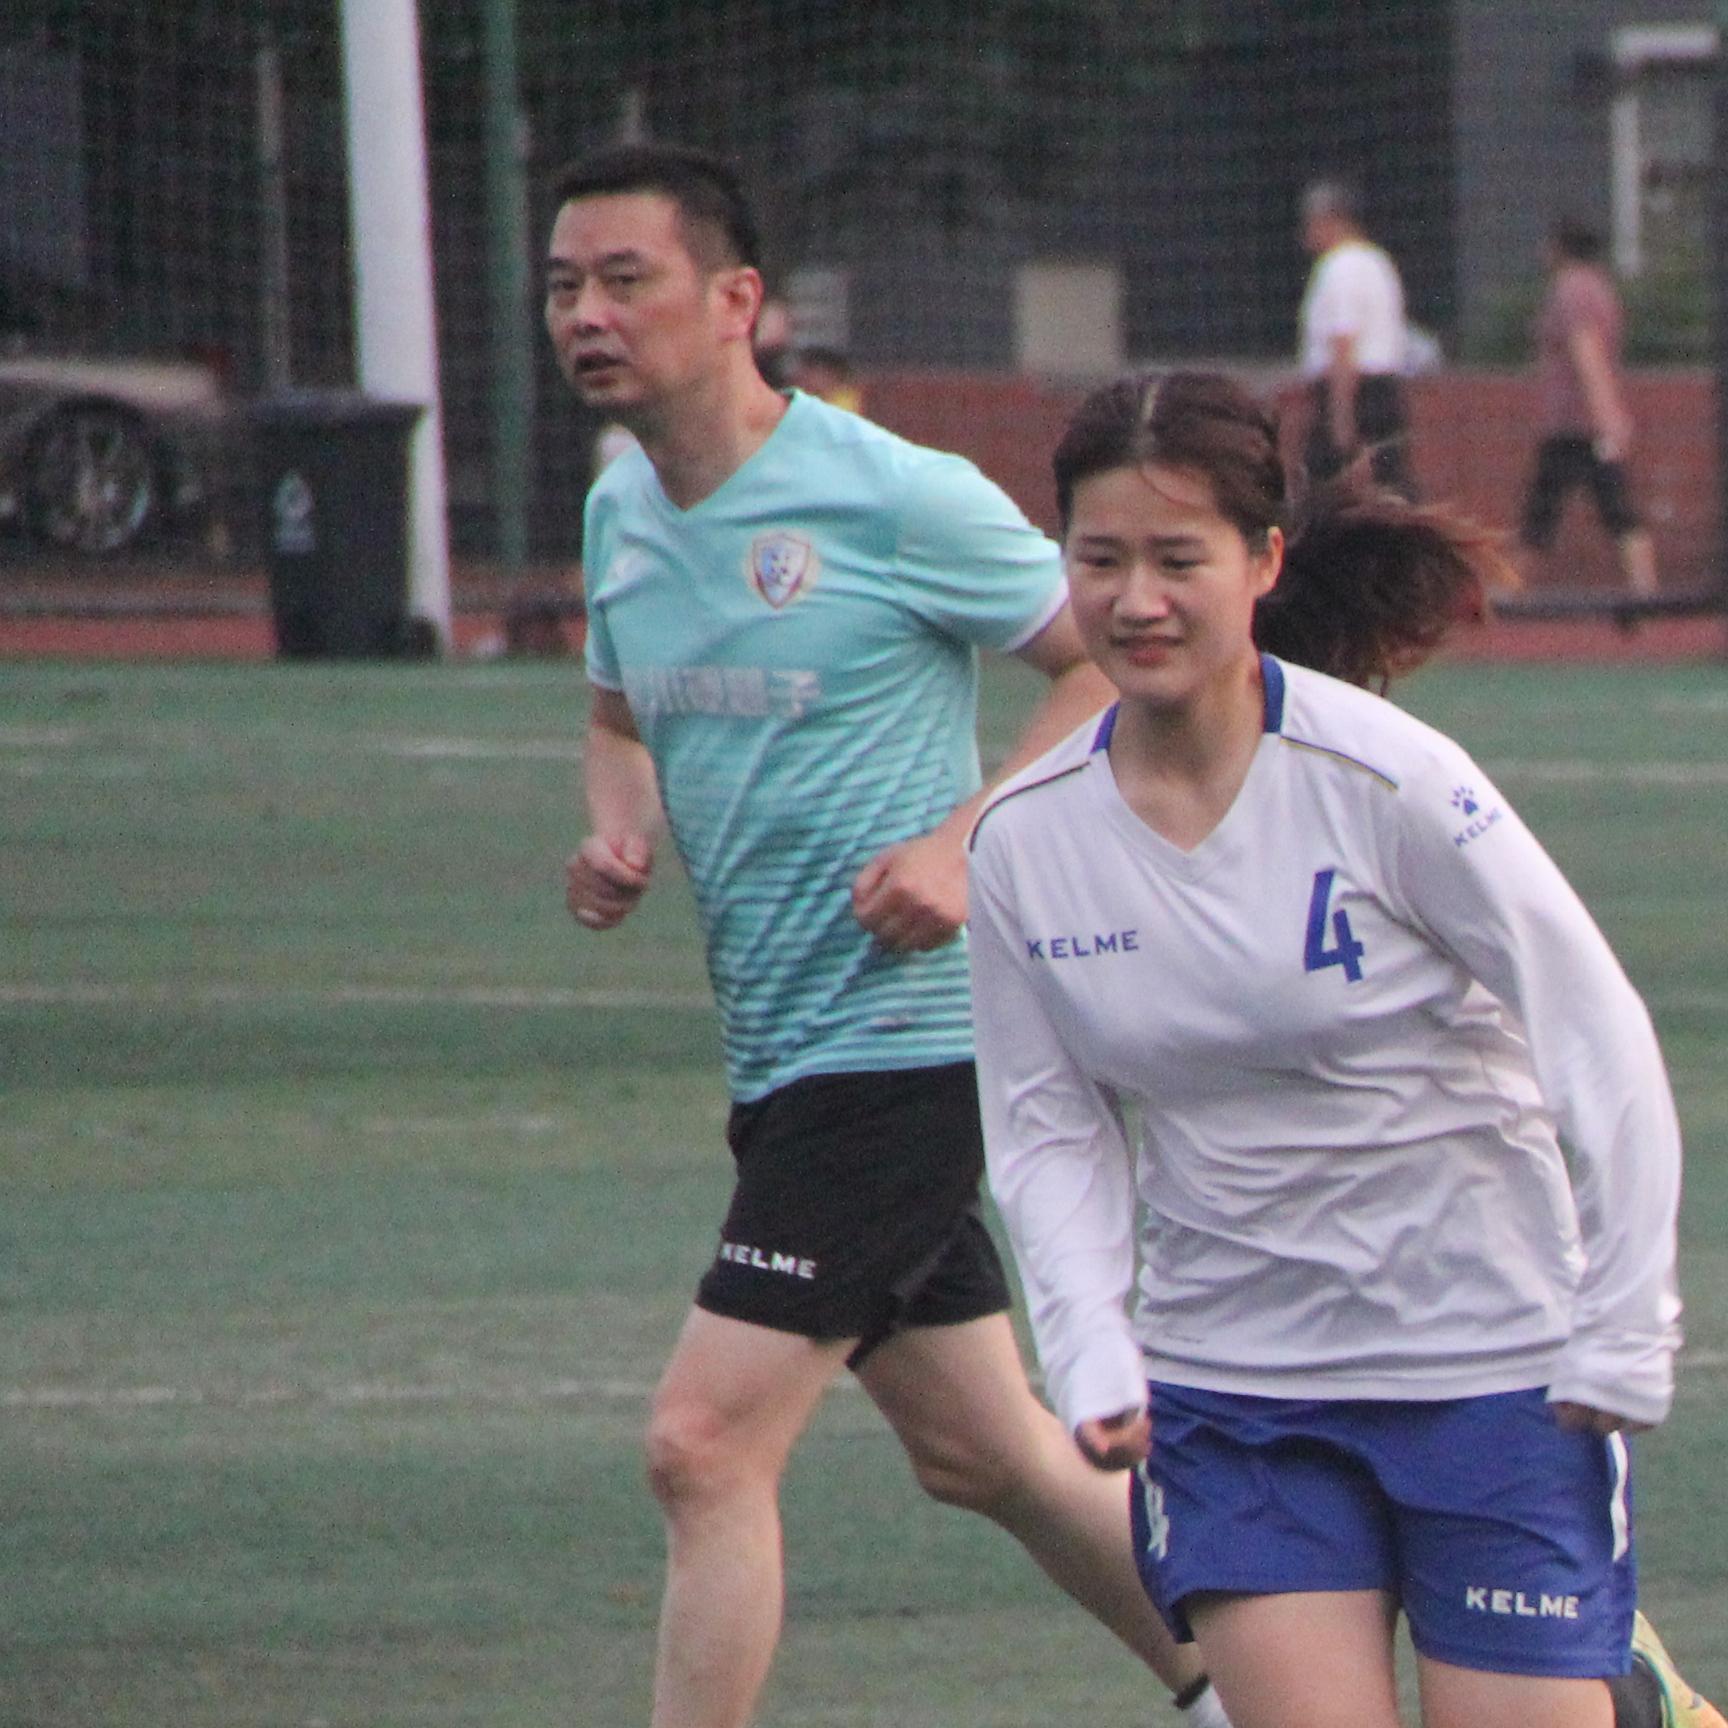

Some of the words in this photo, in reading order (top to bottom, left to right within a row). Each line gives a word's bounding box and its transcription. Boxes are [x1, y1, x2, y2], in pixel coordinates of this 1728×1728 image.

[1305, 869, 1364, 982] 4
[1026, 930, 1140, 960] KELME
[1465, 1586, 1580, 1619] KELME
